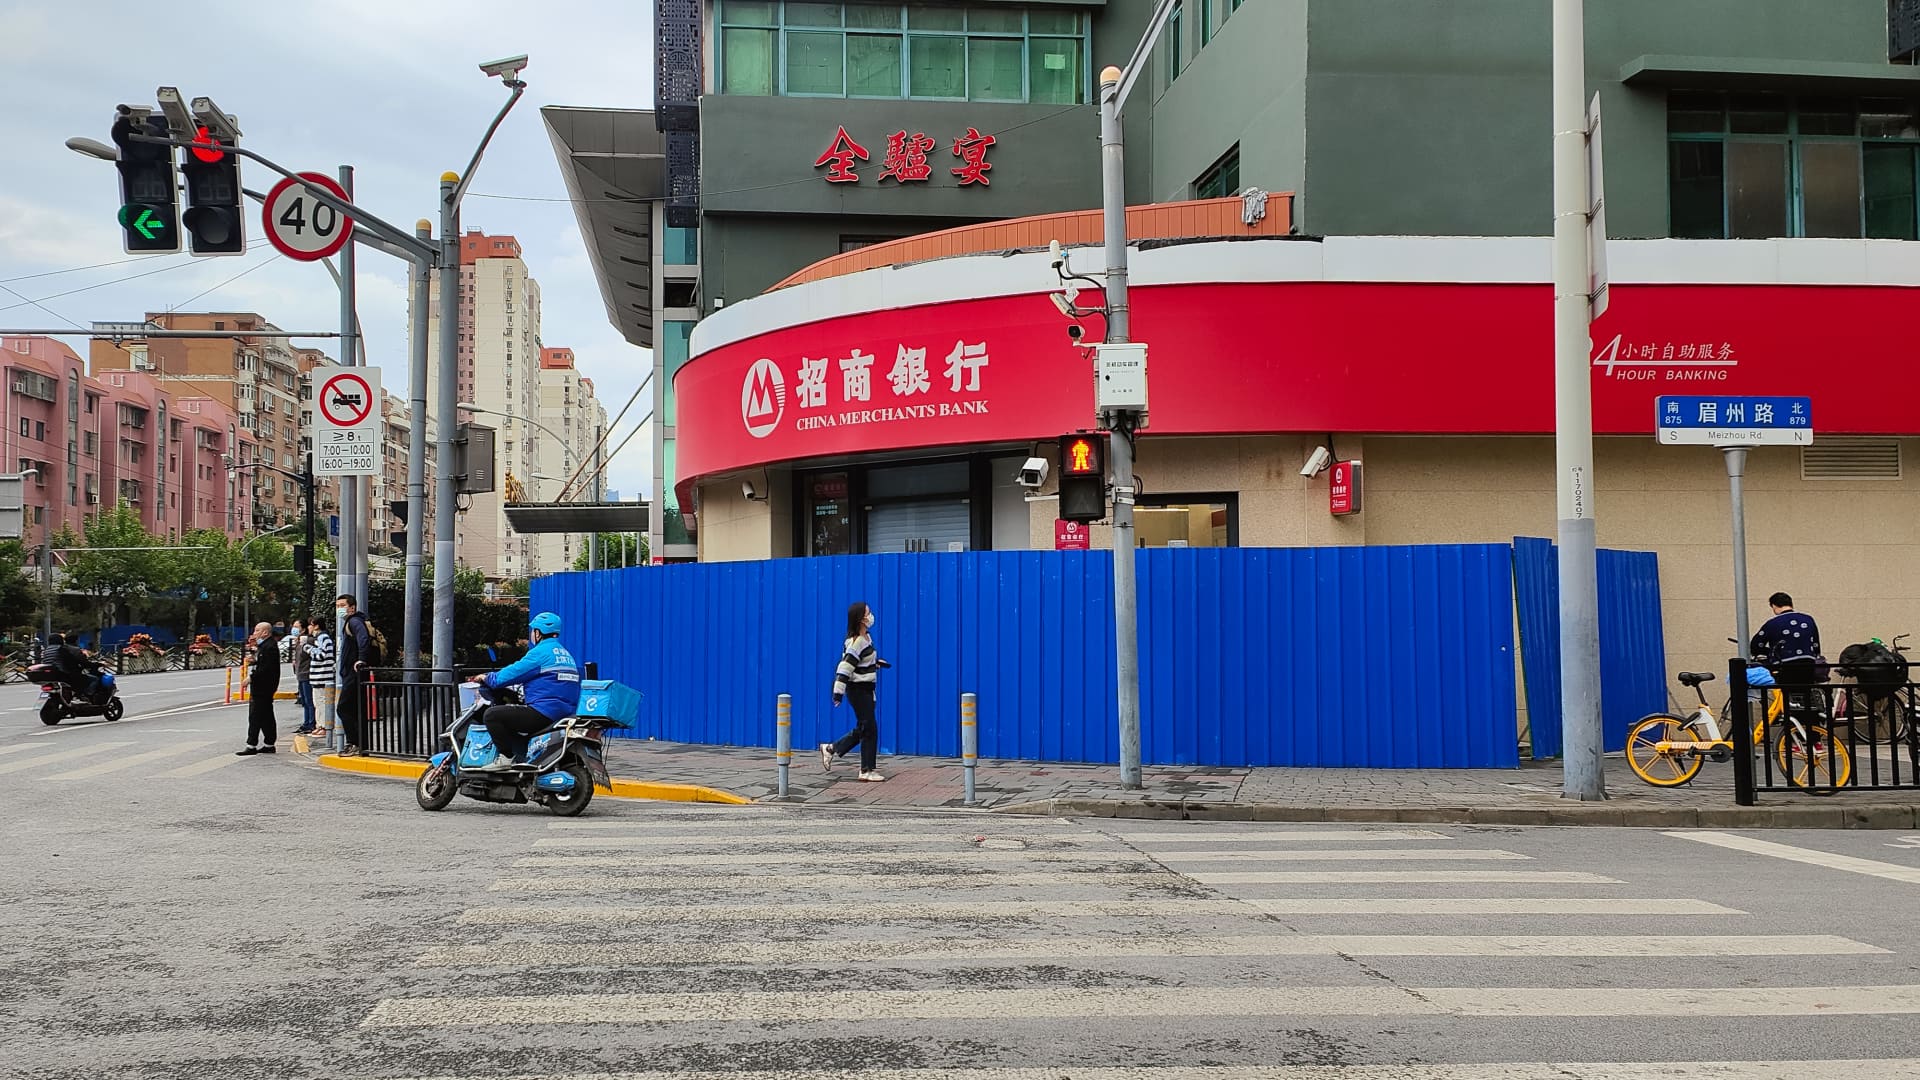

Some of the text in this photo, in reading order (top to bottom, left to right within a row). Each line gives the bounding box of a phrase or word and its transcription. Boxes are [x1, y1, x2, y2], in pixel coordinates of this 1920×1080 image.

[279, 196, 337, 237] 40
[1622, 342, 1735, 360] 小时自助服务
[1616, 370, 1728, 380] HOUR BANKING
[1667, 401, 1679, 414] 南
[1792, 403, 1804, 414] 北
[796, 400, 989, 431] CHINA MERCHANTS BANK
[1698, 402, 1774, 424] 眉州路
[1665, 416, 1682, 425] 875
[1789, 416, 1806, 425] 879
[1670, 431, 1678, 441] S
[1708, 431, 1746, 439] Meizhou
[1794, 431, 1803, 441] N
